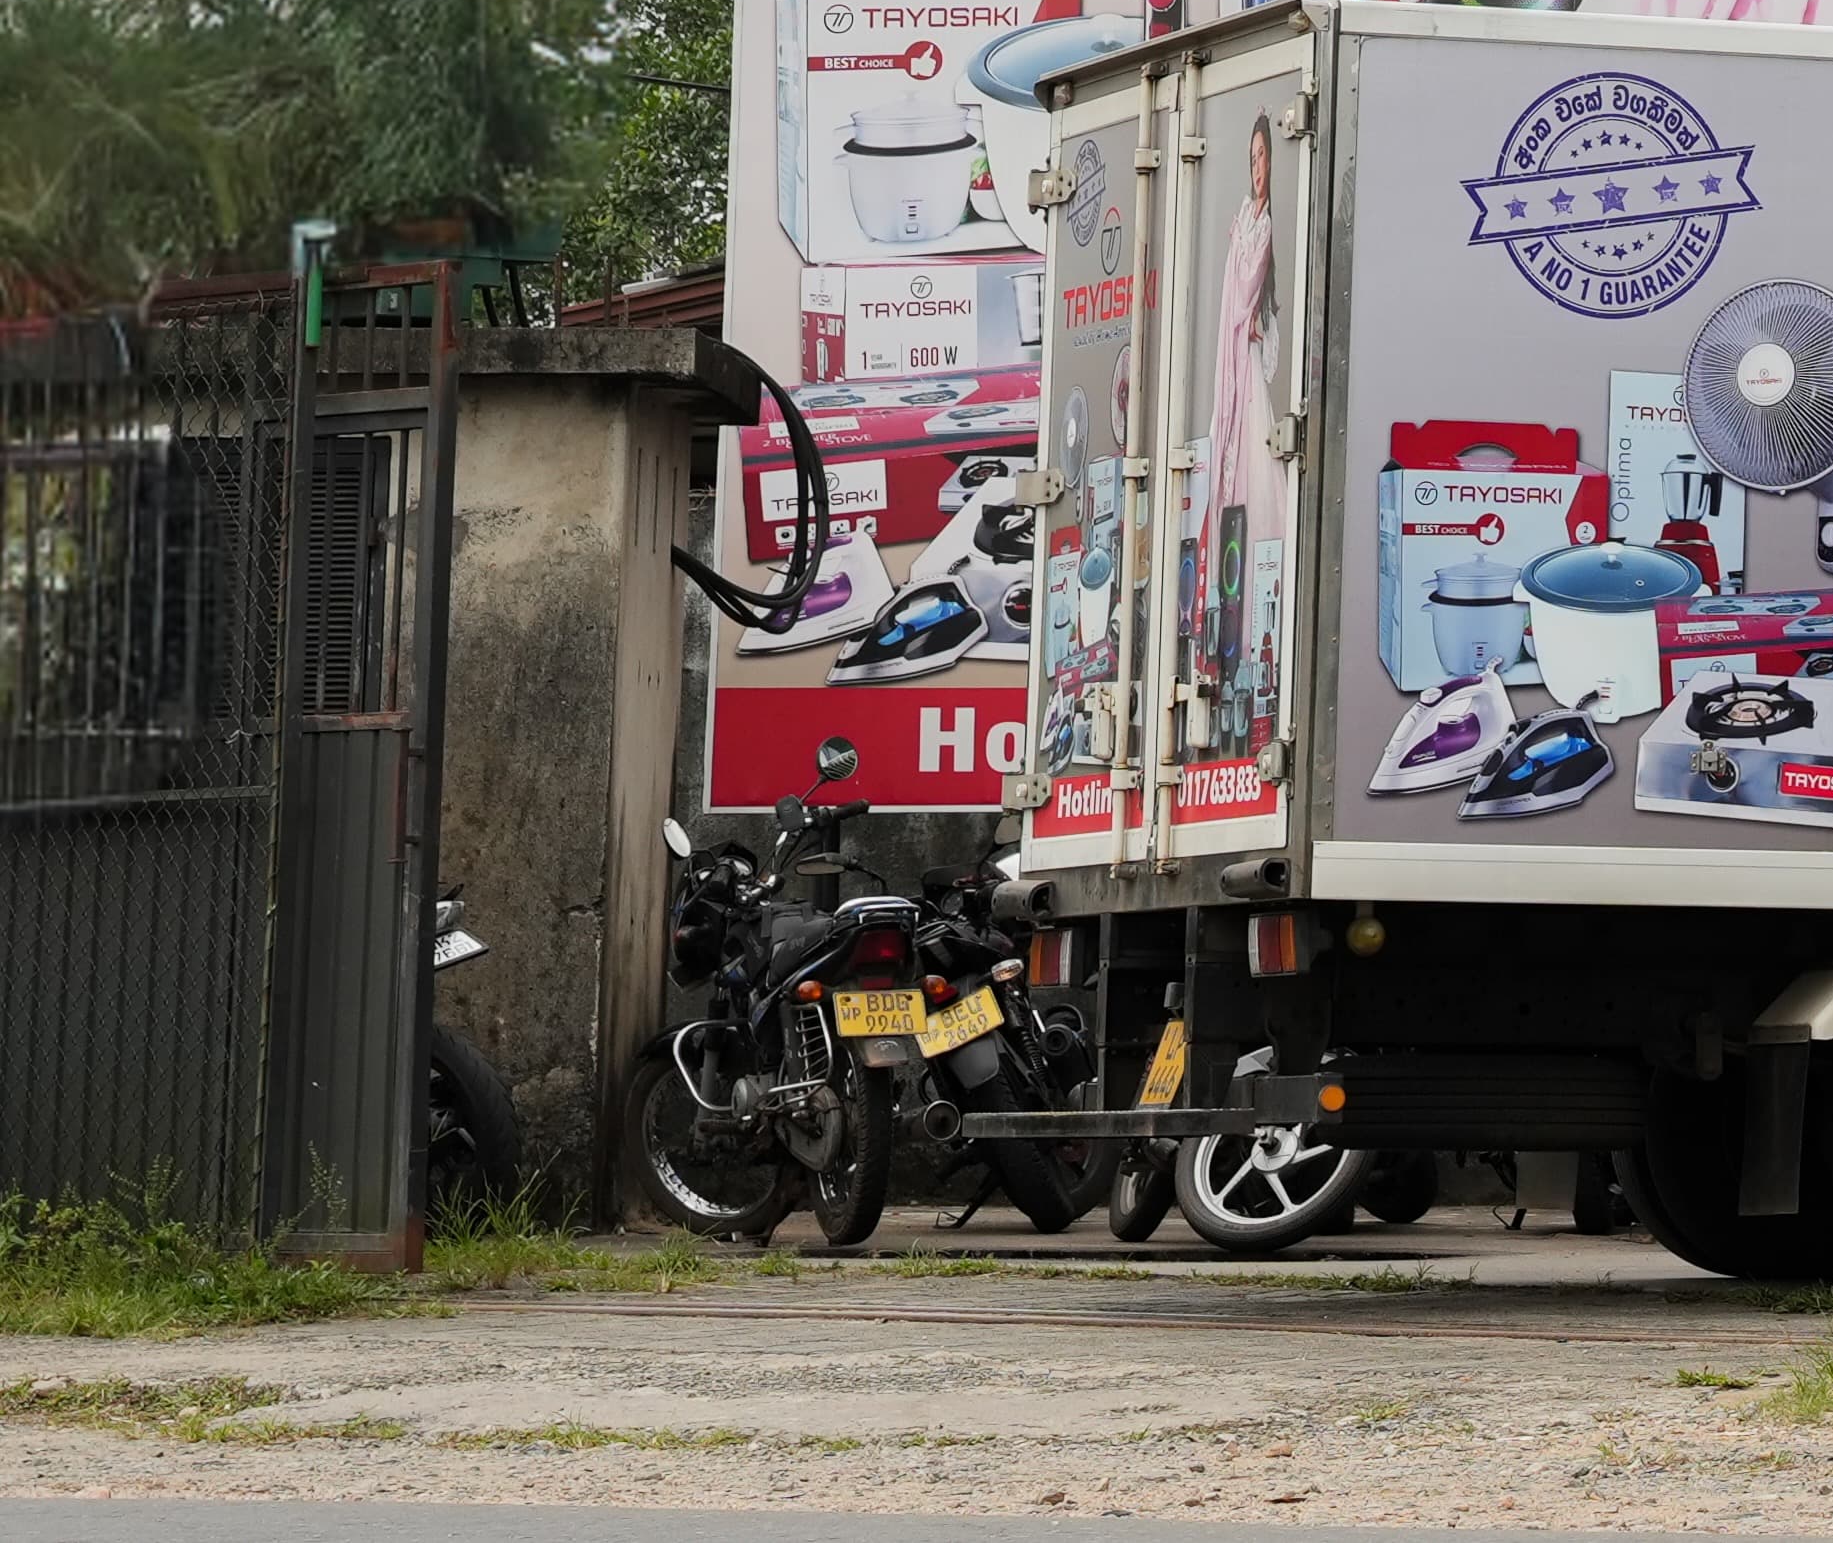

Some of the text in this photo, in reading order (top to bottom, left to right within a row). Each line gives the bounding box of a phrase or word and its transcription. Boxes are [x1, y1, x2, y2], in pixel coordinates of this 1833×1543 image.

[862, 6, 1018, 29] TAYOSAKI
[824, 57, 893, 69] BEST CHOICE
[1514, 117, 1551, 169] අංක
[1523, 222, 1710, 305] A NO 1 GUARANTEE
[859, 300, 971, 318] TAYOSAKI
[862, 351, 867, 370] 1
[910, 347, 939, 367] 600
[944, 346, 958, 365] W
[825, 433, 873, 446] STOVE
[1610, 438, 1635, 522] Optima
[772, 490, 878, 511] TASAKI
[1444, 485, 1562, 504] TAYOSAKI
[1415, 524, 1440, 534] BEST
[1057, 780, 1113, 818] Hotlin
[841, 1007, 862, 1021] WP
